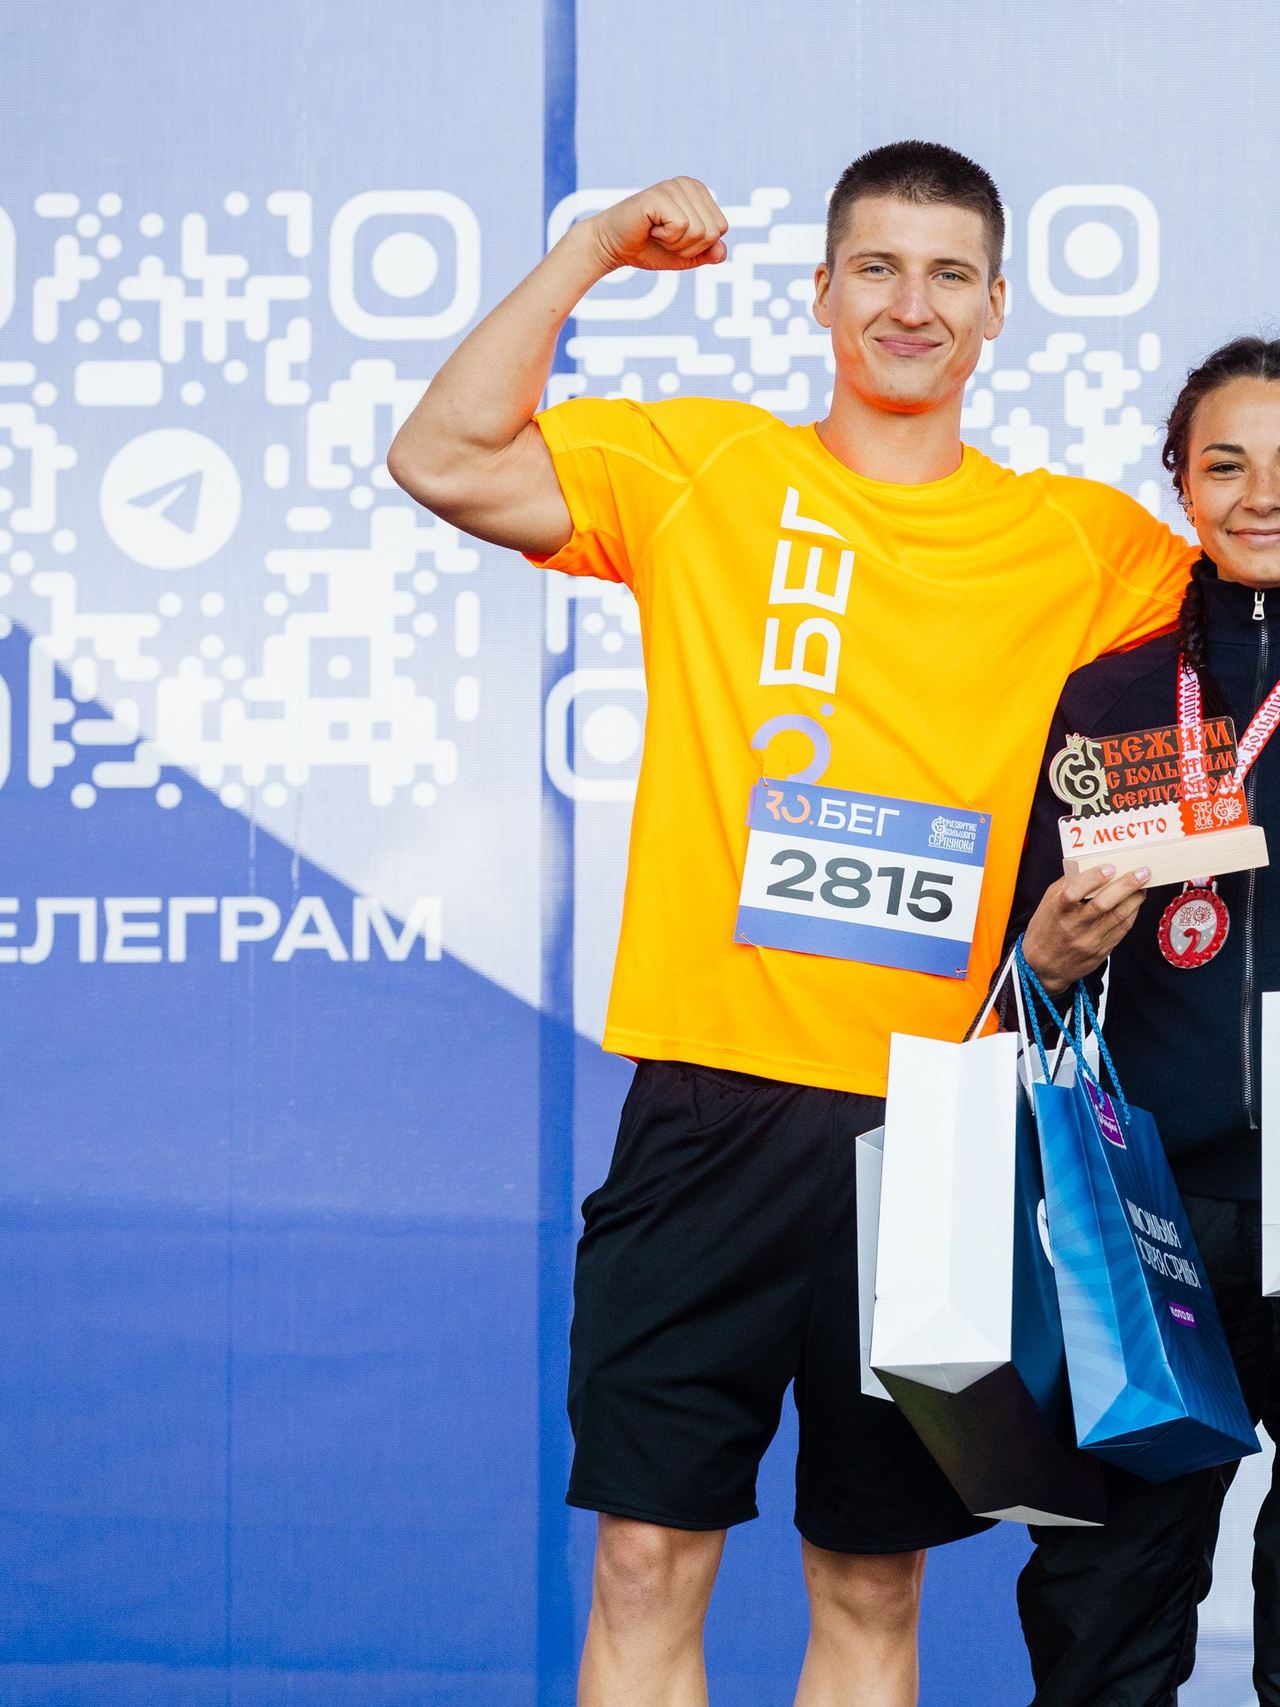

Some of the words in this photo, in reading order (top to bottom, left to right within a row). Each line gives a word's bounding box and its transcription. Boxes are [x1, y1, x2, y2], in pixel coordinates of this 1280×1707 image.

[1101, 720, 1233, 768] БЕЖИМ
[1105, 771, 1120, 790] С
[1124, 750, 1238, 786] БОЛЬШИМ
[928, 833, 975, 852] СЕРПУХОВА
[1069, 825, 1084, 849] 2
[1093, 817, 1167, 845] МЕСТО
[766, 849, 954, 923] 2815
